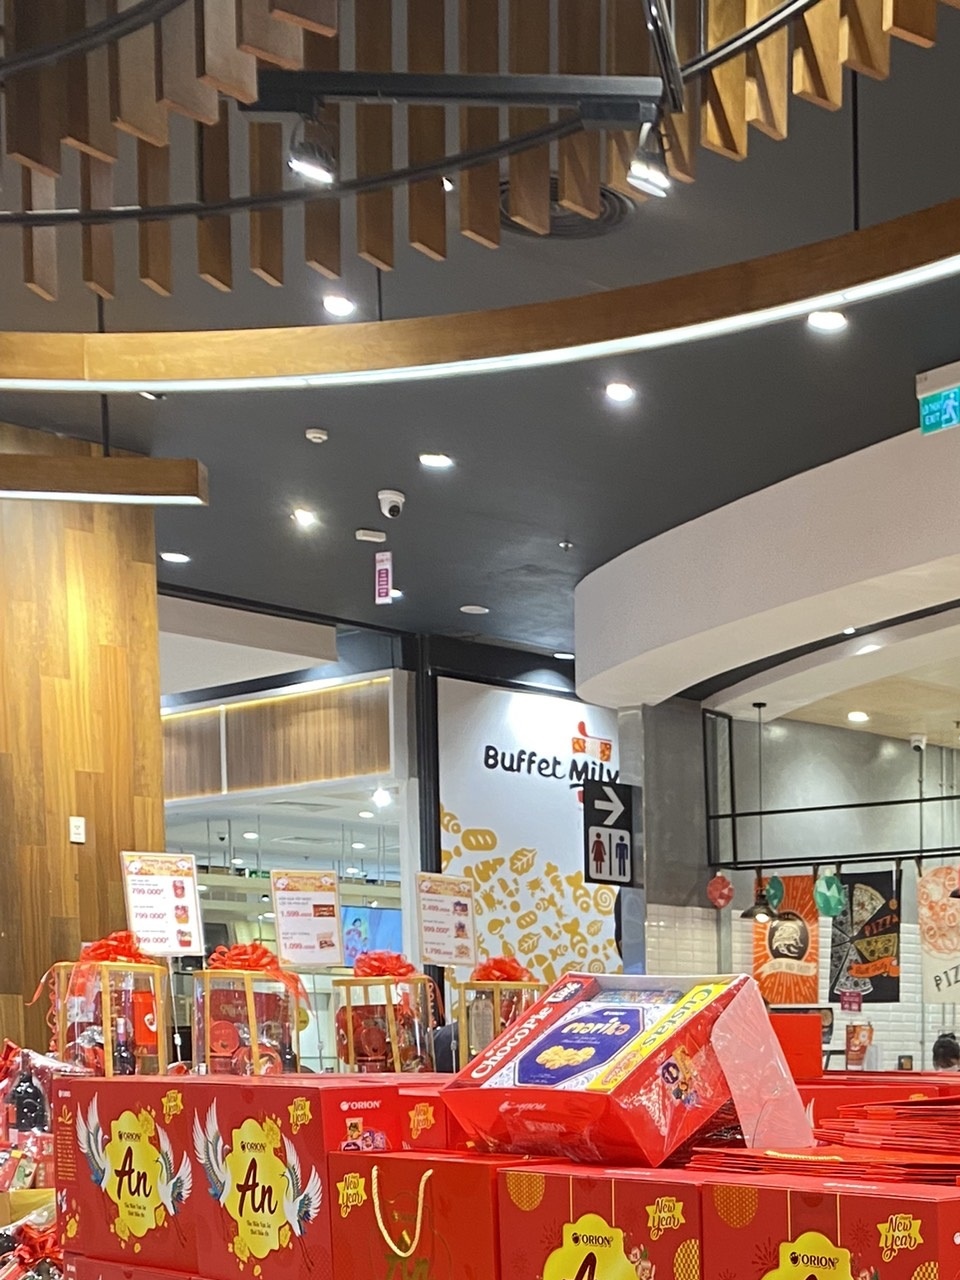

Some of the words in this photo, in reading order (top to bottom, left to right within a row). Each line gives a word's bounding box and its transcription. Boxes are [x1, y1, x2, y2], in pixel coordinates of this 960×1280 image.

[484, 745, 566, 779] Buffet
[864, 915, 898, 936] PIZZA
[351, 1101, 381, 1109] ORION
[115, 1146, 152, 1200] An
[343, 1175, 360, 1190] New
[236, 1157, 278, 1217] An
[341, 1189, 363, 1216] Year
[655, 1200, 676, 1213] New
[651, 1213, 679, 1238] Year
[887, 1216, 912, 1233] New
[582, 1234, 610, 1246] ORION
[884, 1232, 917, 1260] Year
[800, 1254, 836, 1268] ORION
